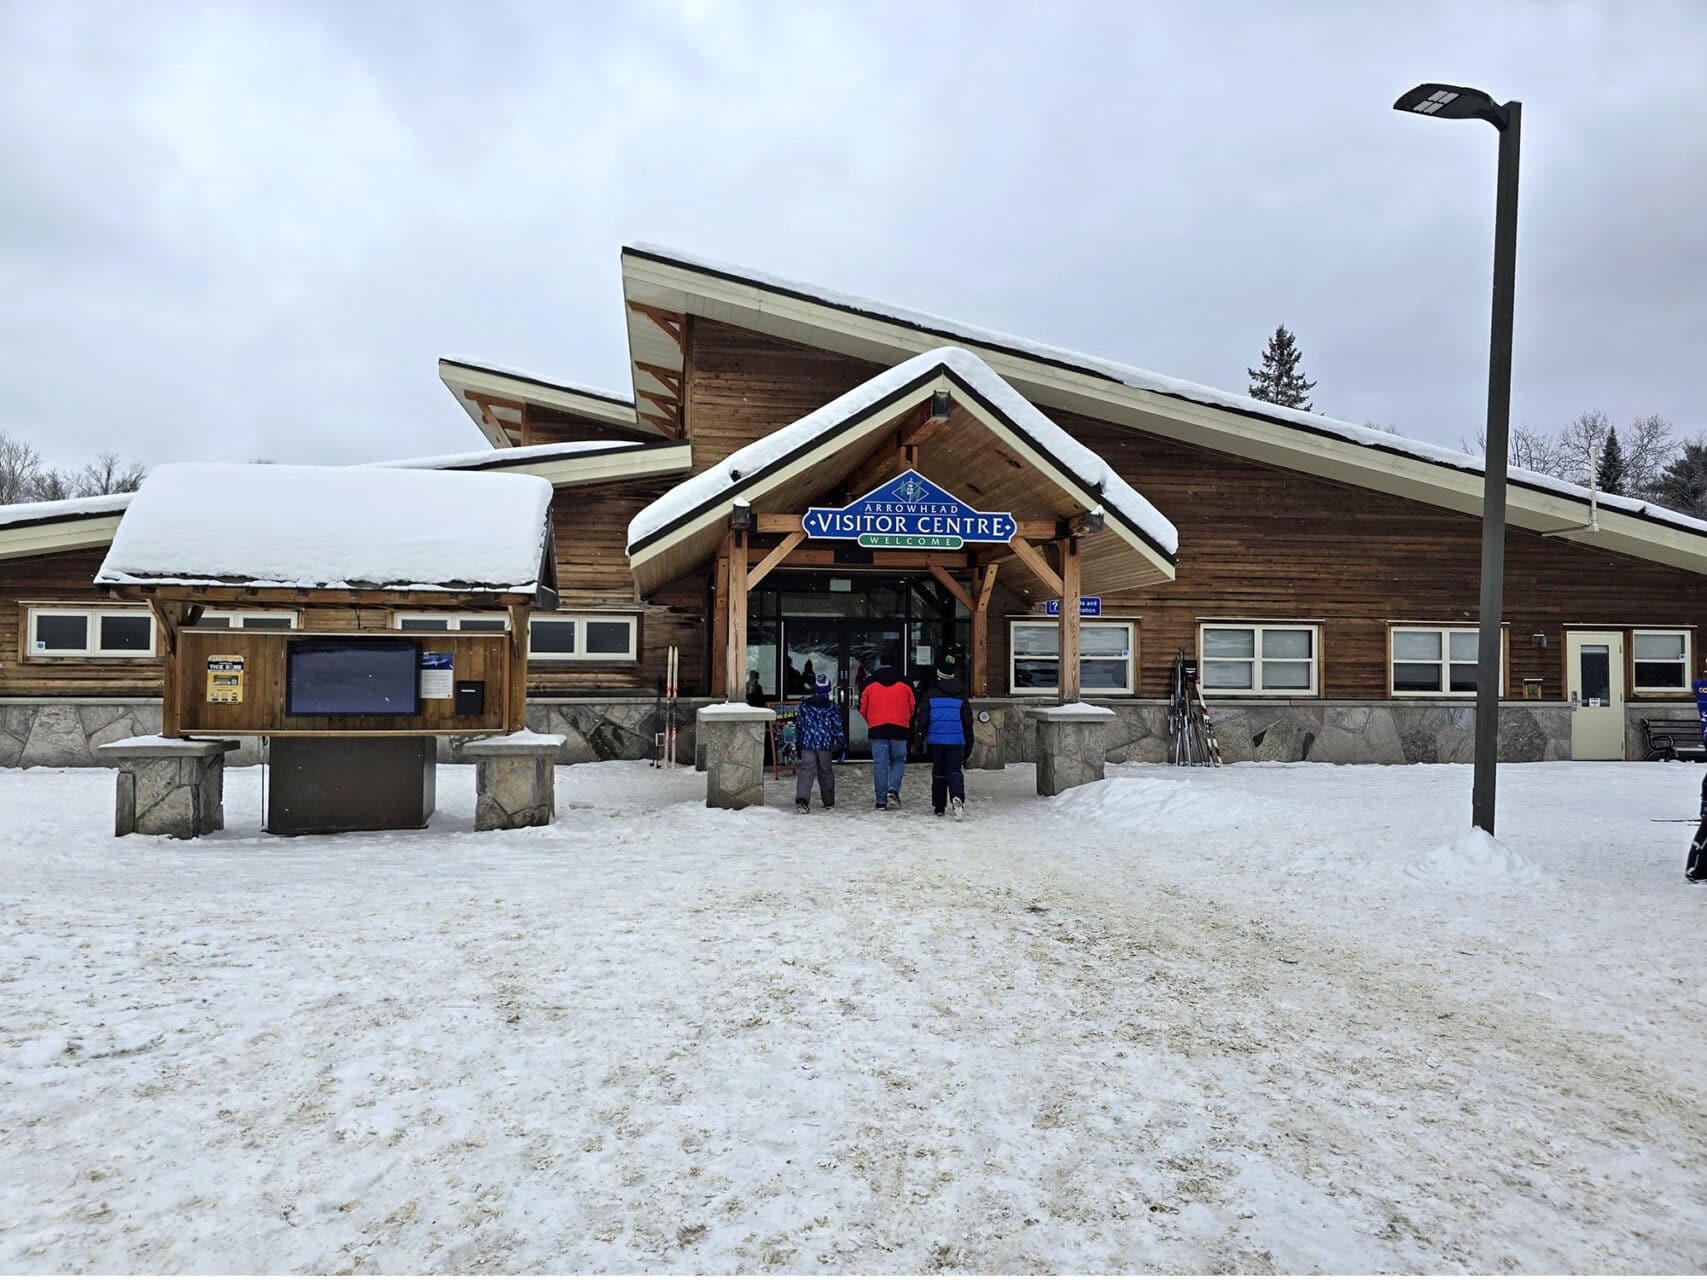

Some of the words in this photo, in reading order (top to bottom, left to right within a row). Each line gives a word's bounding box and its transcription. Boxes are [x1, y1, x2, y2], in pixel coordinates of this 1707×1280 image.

[864, 503, 959, 514] ARROWHEAD
[816, 512, 908, 533] VISITOR
[917, 516, 1005, 536] CENTRE
[869, 536, 952, 546] WELCOME
